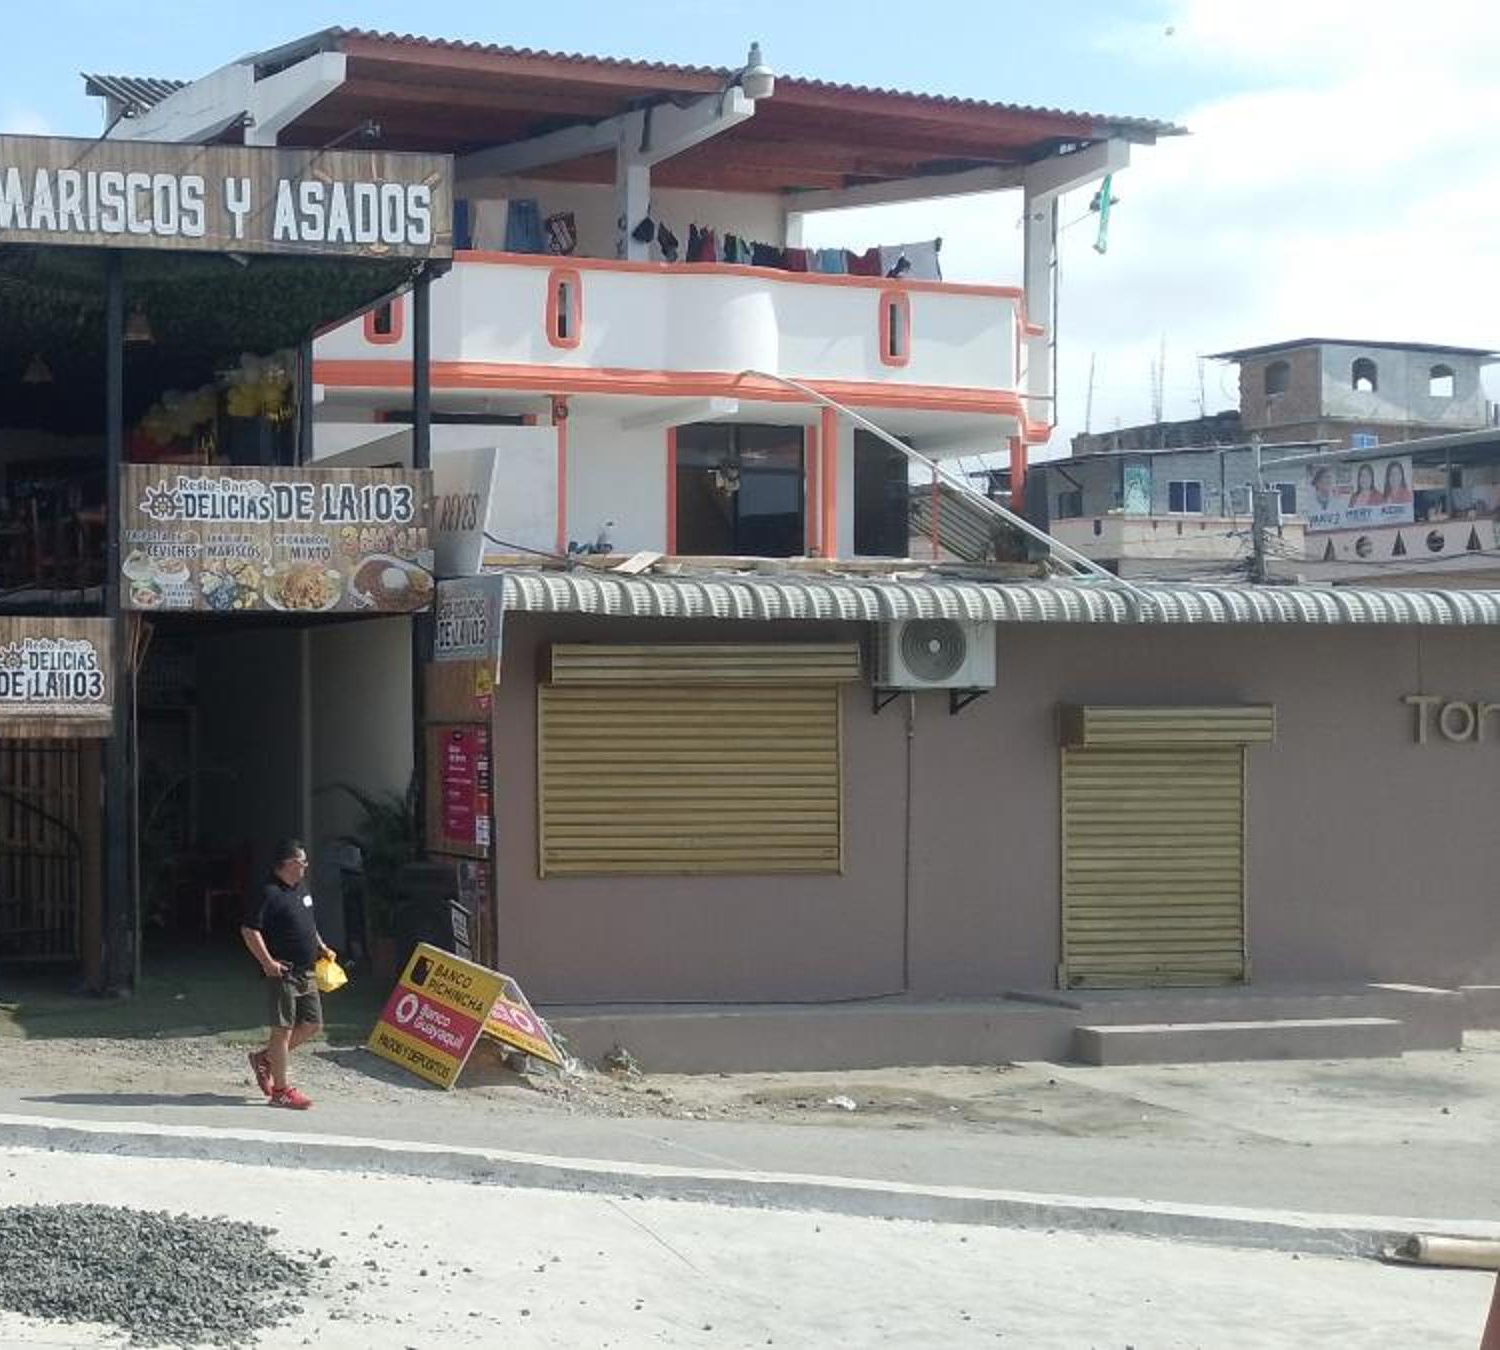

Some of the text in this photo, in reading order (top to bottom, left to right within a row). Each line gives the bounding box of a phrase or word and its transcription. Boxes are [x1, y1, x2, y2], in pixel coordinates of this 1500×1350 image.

[225, 177, 251, 238] Y
[273, 179, 432, 245] ASADOS
[182, 494, 270, 519] DELICIAS
[272, 485, 314, 521] DE
[322, 485, 357, 522] LA
[361, 486, 413, 522] 103
[147, 544, 197, 558] CEVICHES
[207, 545, 261, 559] MARISCOS
[290, 547, 331, 560] MIXTO
[34, 672, 58, 697] LA
[65, 673, 102, 698] 103
[434, 964, 473, 988] BANCO
[428, 979, 484, 1011] PICHINCHA
[419, 1003, 451, 1027] Banco
[414, 1017, 465, 1049] Guayaquil
